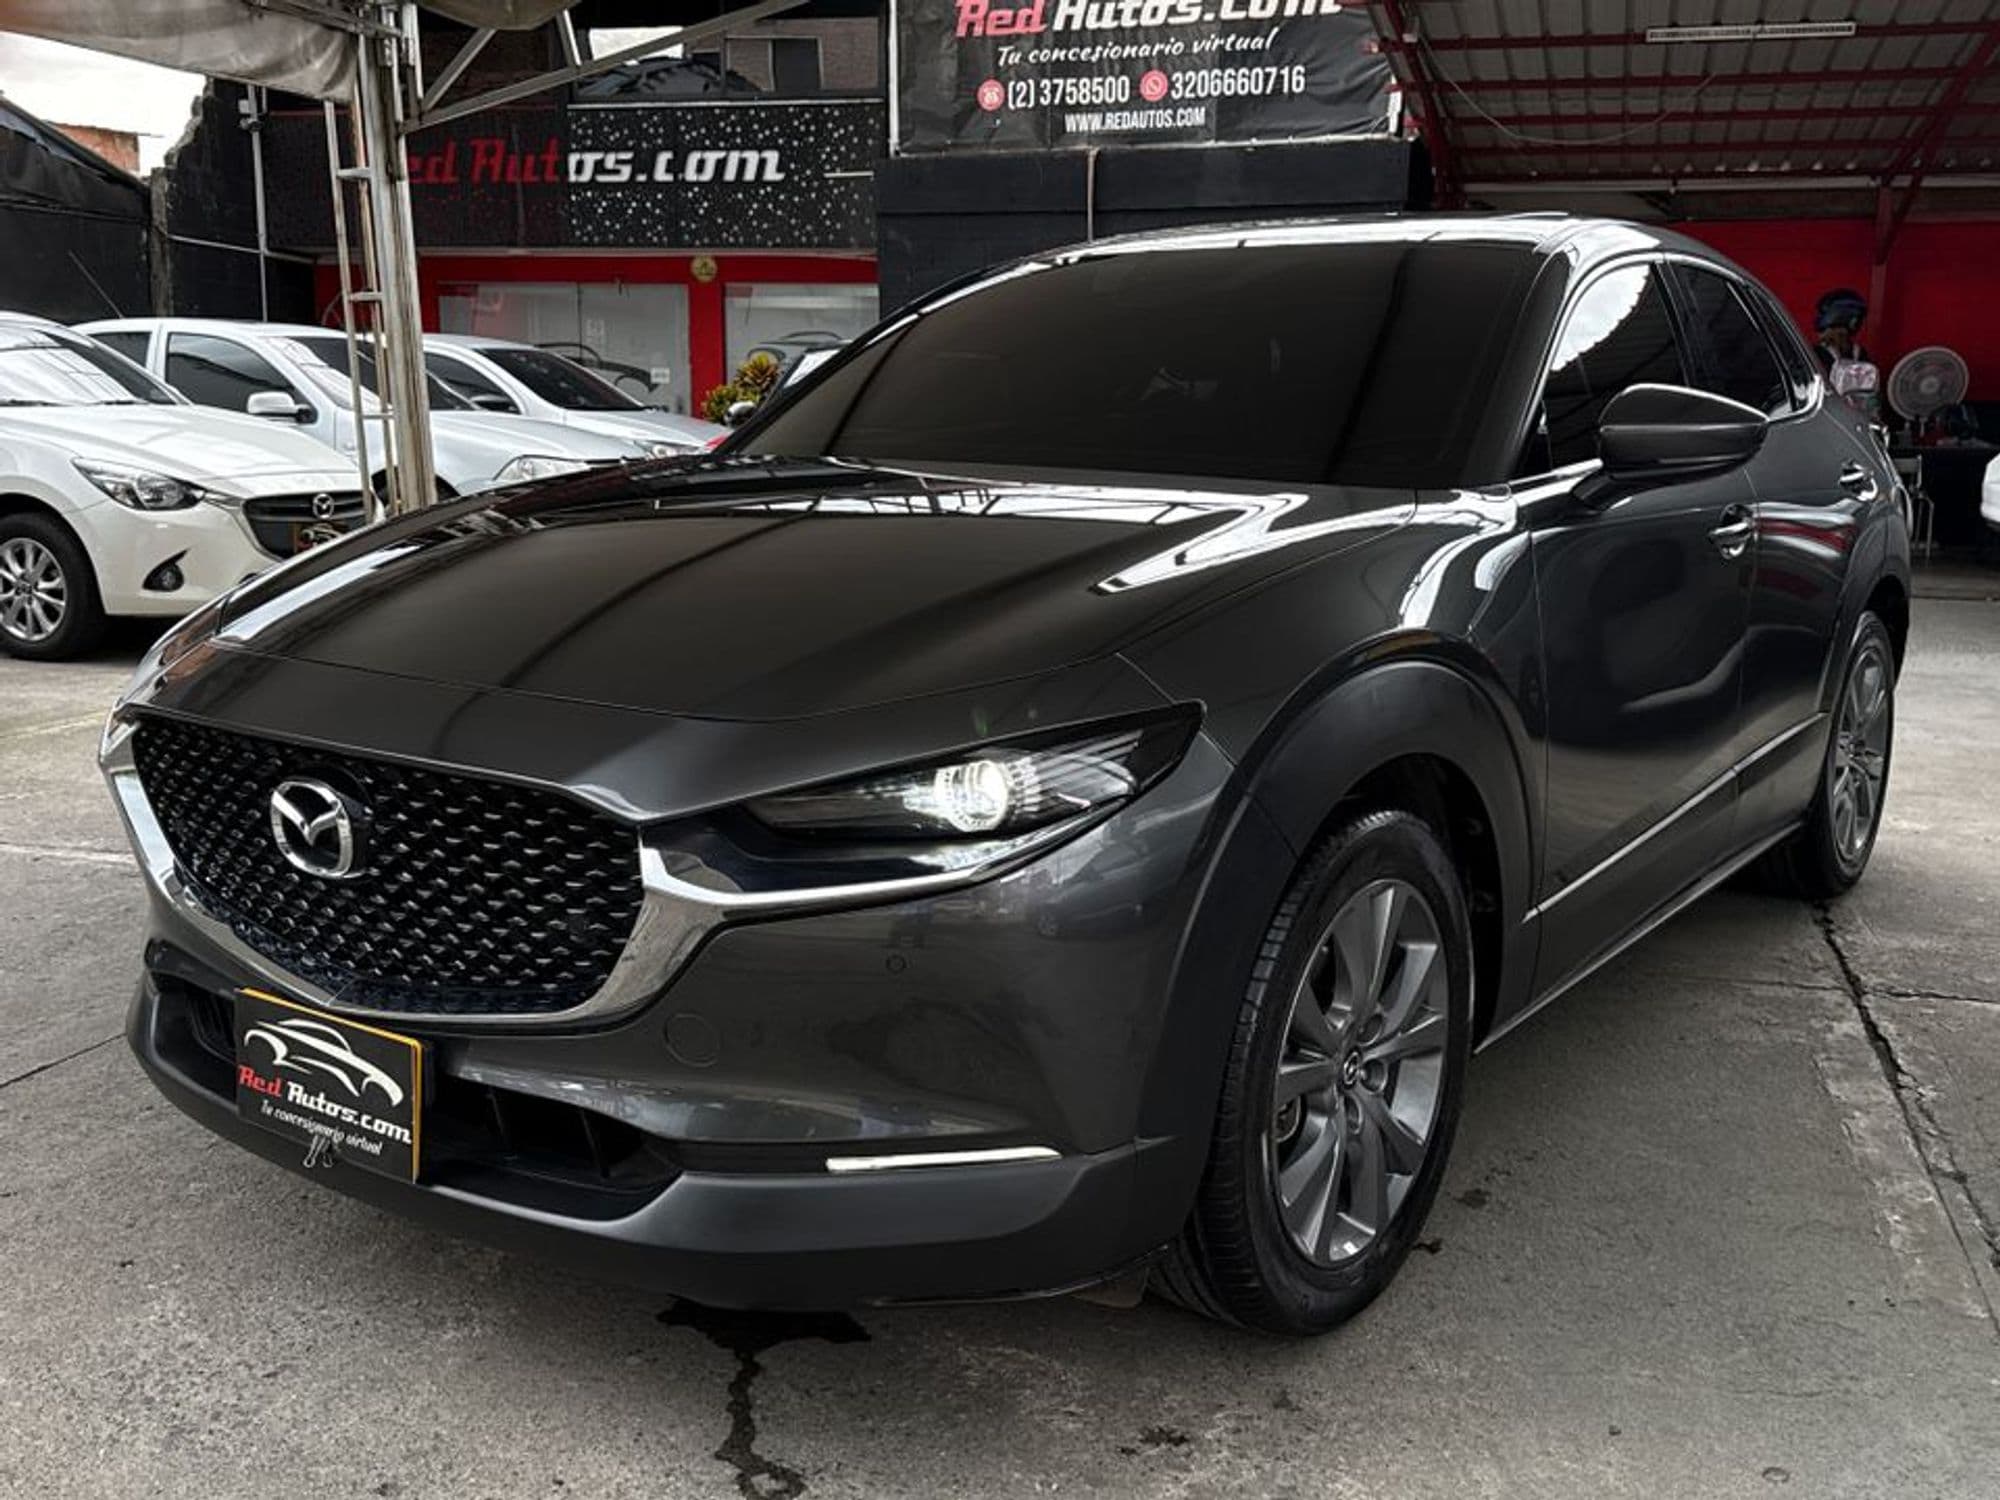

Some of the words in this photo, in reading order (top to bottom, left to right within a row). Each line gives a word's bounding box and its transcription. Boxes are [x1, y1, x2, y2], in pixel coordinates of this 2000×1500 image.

[956, 0, 1047, 37] Red
[998, 46, 1021, 67] Tu
[1028, 36, 1185, 64] concesionario
[1191, 26, 1280, 53] virtual
[1008, 79, 1035, 110] (2)
[1039, 75, 1130, 106] 3758500
[1170, 65, 1305, 100] 3206660716
[1064, 106, 1206, 133] WWW.REDAUTOS.COM
[407, 139, 457, 184] ed
[239, 1064, 282, 1098] Red
[287, 1080, 412, 1145] Autos.com
[346, 1132, 382, 1156] virtual
